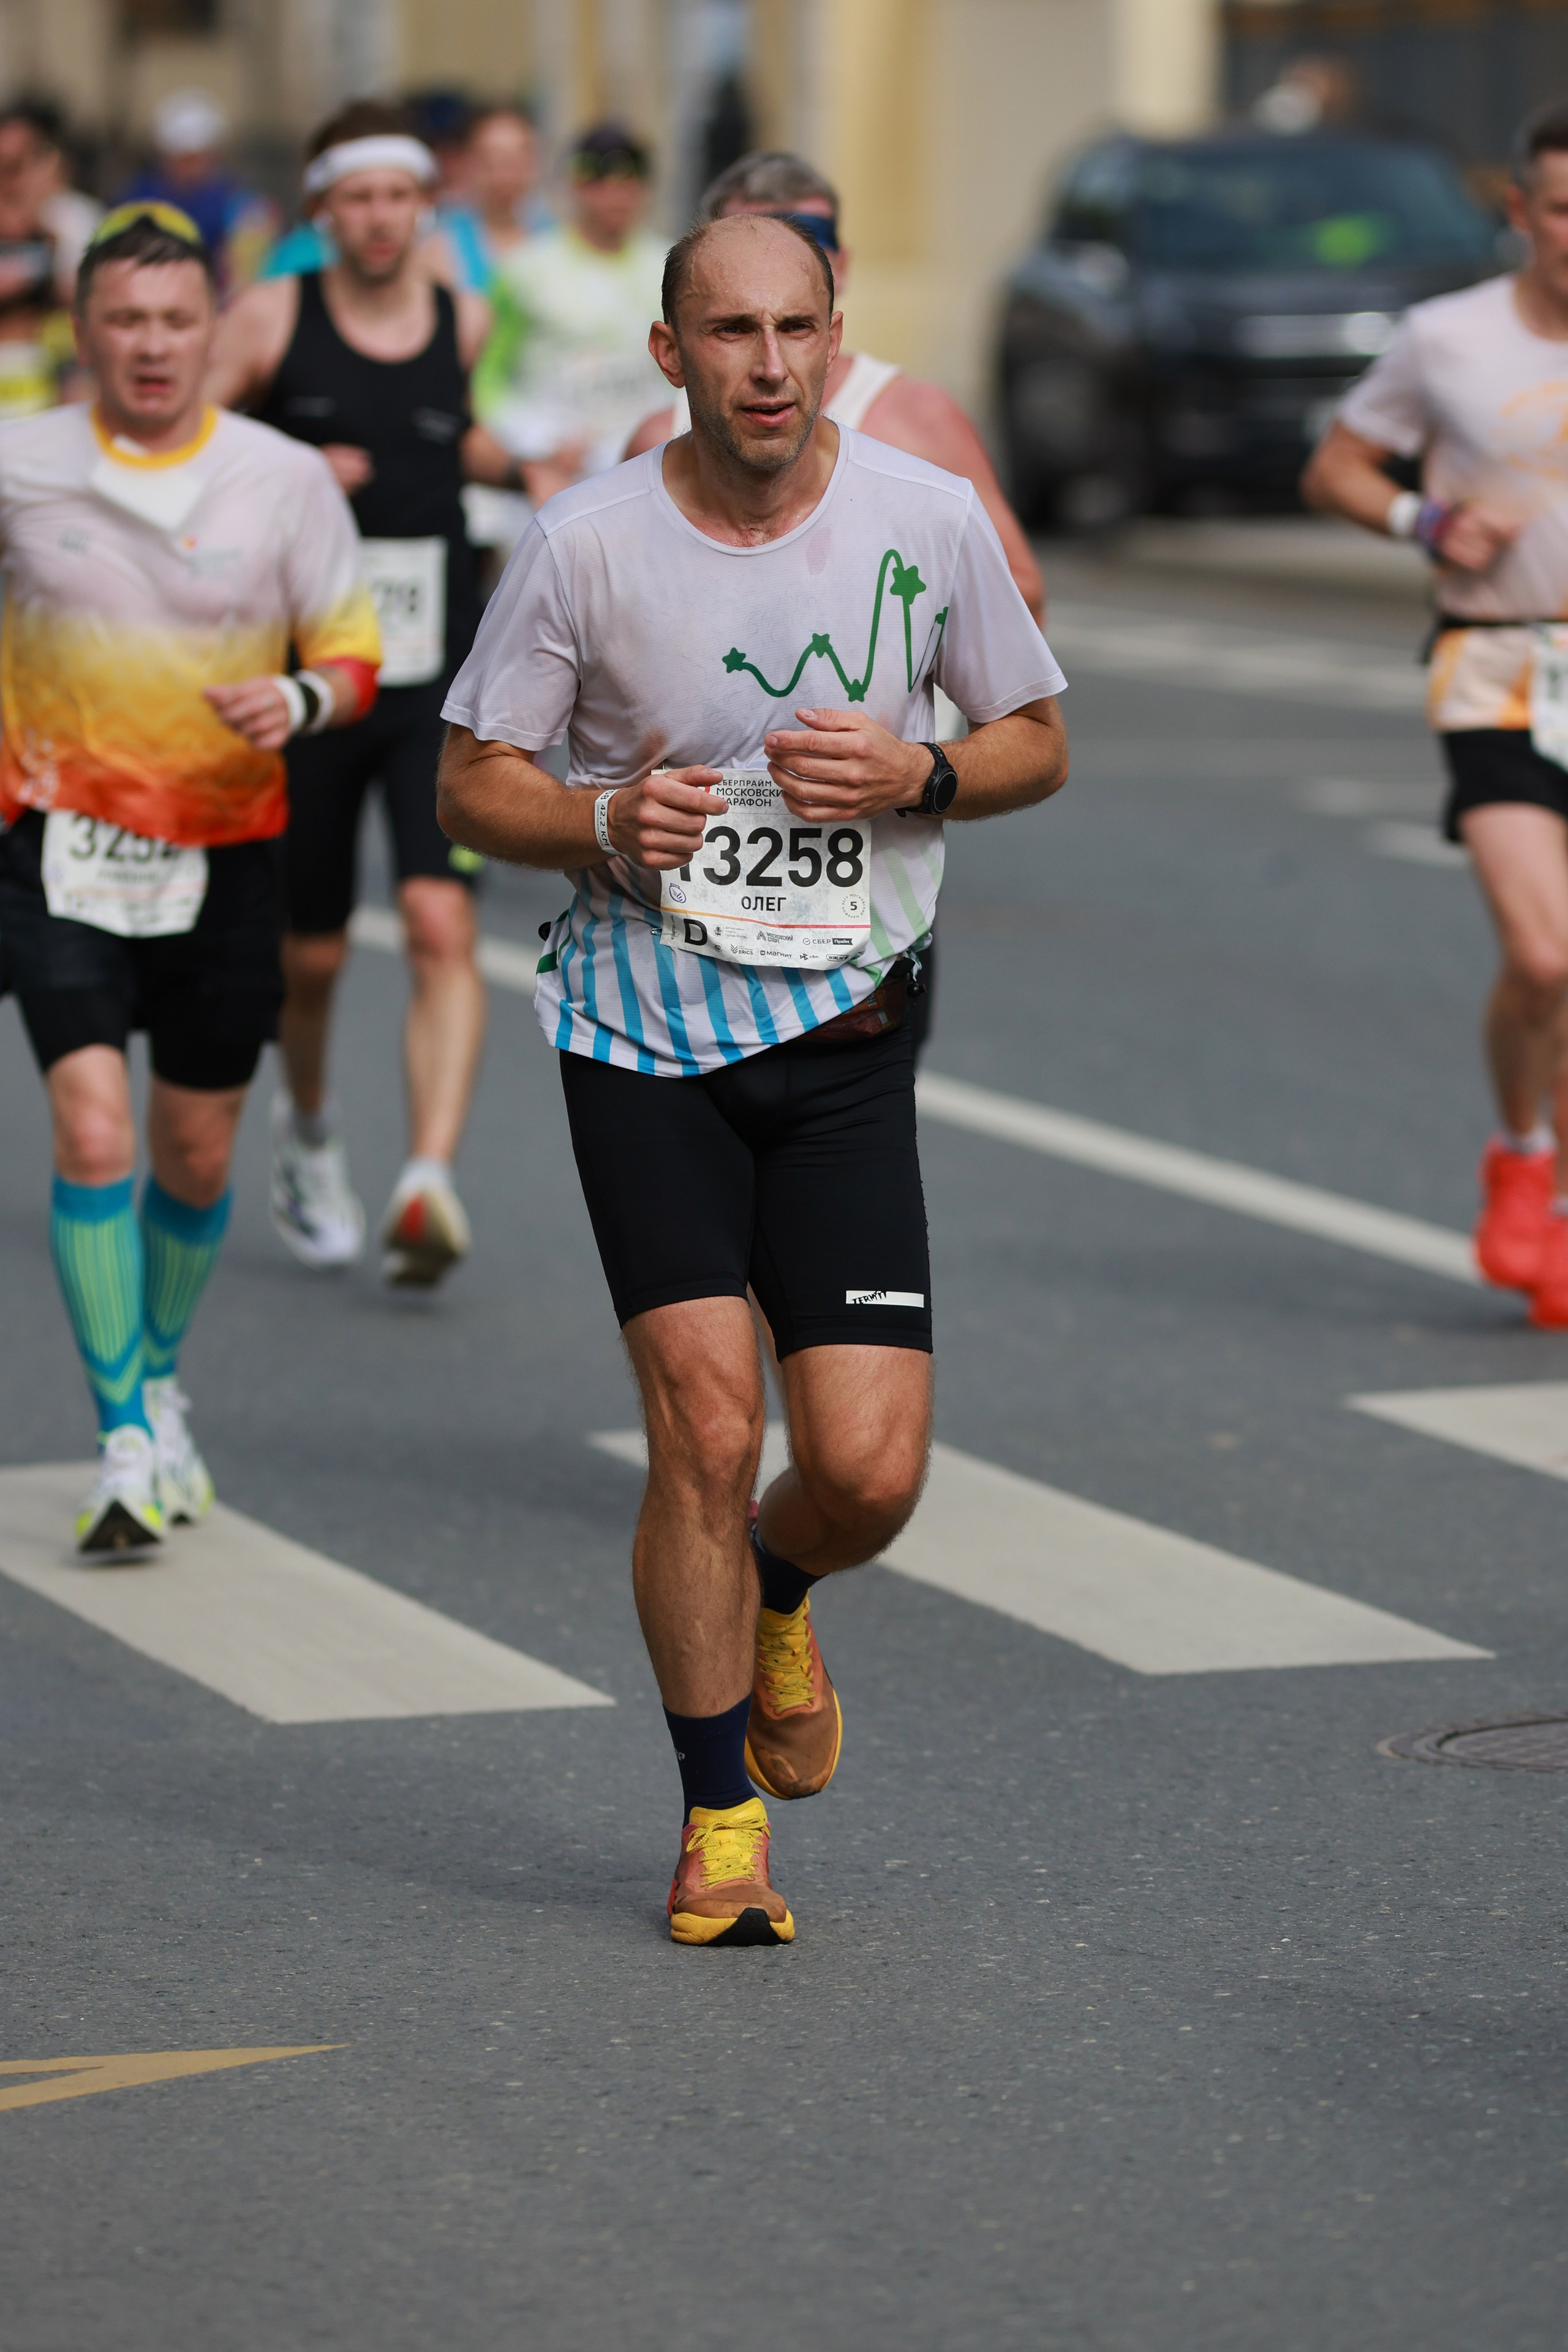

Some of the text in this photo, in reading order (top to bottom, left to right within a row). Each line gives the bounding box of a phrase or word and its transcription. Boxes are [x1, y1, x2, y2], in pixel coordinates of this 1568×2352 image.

[723, 797, 772, 807] АРАФОН
[679, 826, 864, 888] 3258
[741, 896, 786, 911] ОЛЕГ
[850, 901, 858, 911] 5
[683, 918, 708, 946] D
[766, 932, 794, 941] МОСКОВСКИЙ
